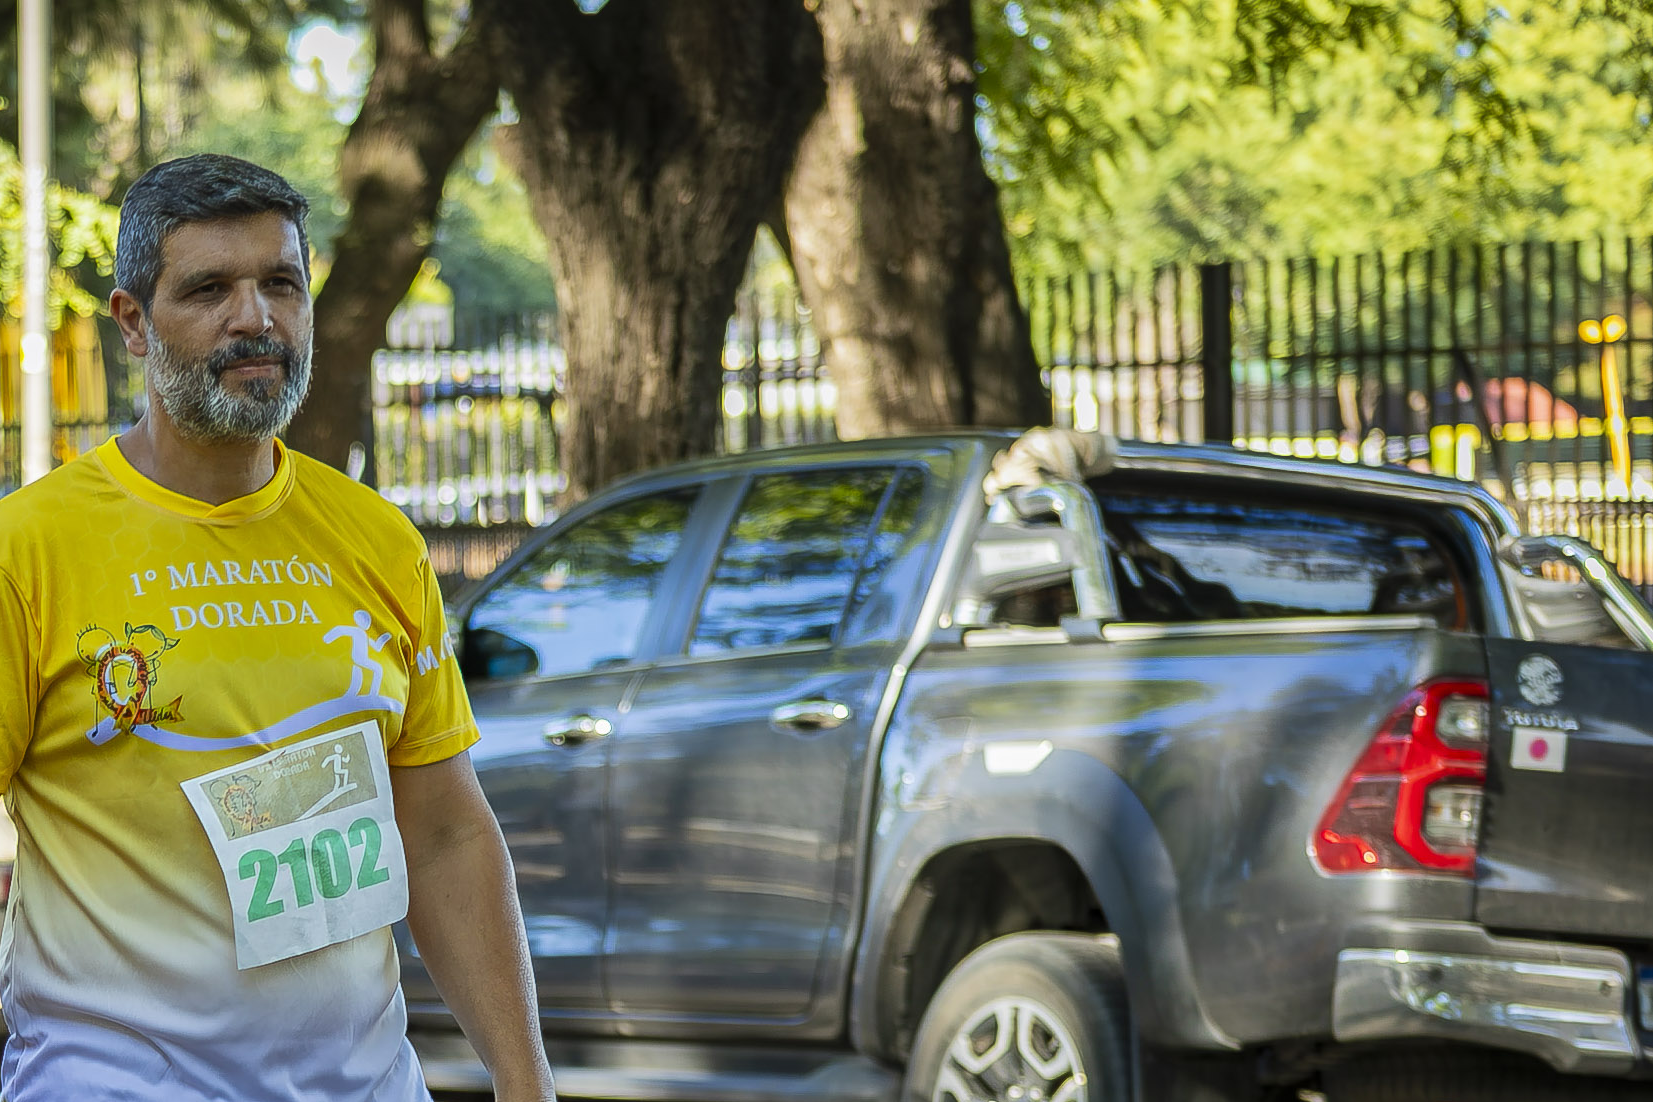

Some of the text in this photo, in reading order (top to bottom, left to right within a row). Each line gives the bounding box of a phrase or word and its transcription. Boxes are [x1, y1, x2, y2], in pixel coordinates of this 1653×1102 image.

[129, 554, 334, 597] 1° MARATÓN
[169, 600, 322, 632] DORADA
[237, 817, 390, 923] 2102
